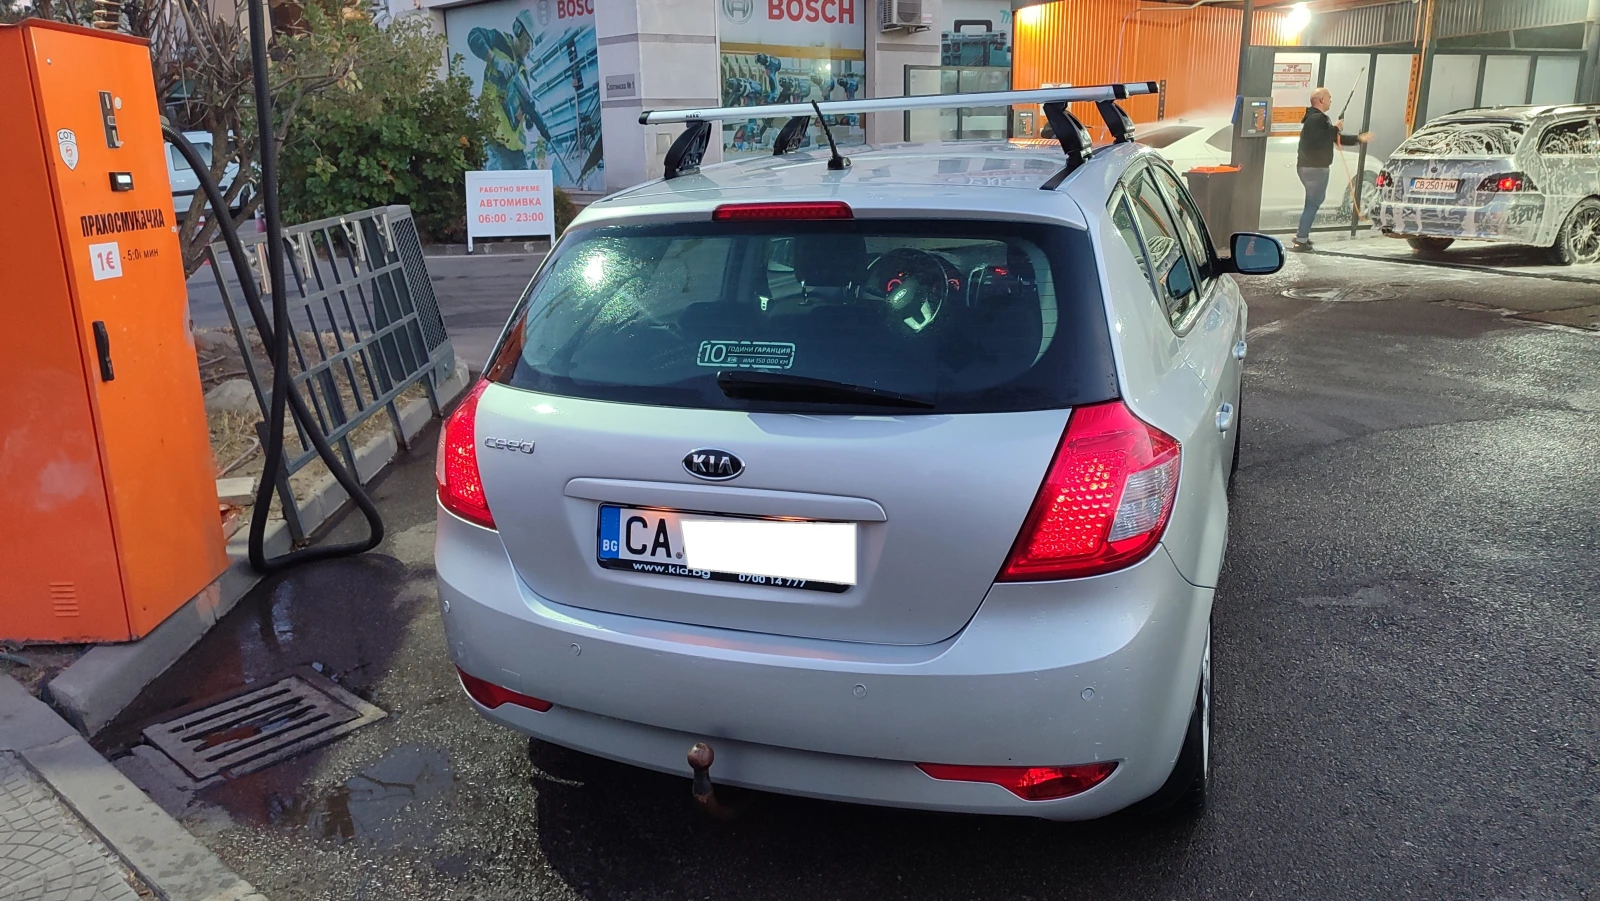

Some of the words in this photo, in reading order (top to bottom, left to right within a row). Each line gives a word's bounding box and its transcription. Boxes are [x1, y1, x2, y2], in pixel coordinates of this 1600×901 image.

[768, 0, 854, 24] BOSCH
[479, 186, 514, 194] РАБОТНО
[1425, 180, 1443, 190] 2501
[478, 197, 542, 208] АВТОМИВКА
[80, 208, 165, 238] ПРАХОСМУКАЧКА
[478, 213, 506, 224] 06:00
[516, 212, 544, 222] 23:00
[97, 250, 115, 272] 1€
[144, 248, 158, 258] мин
[702, 344, 726, 363] 10
[692, 454, 733, 474] KIA
[625, 516, 672, 558] CA
[602, 540, 618, 552] BG
[632, 562, 710, 579] www.kia.bg
[738, 574, 765, 584] 0700
[770, 576, 782, 585] 14
[786, 579, 806, 588] 777
